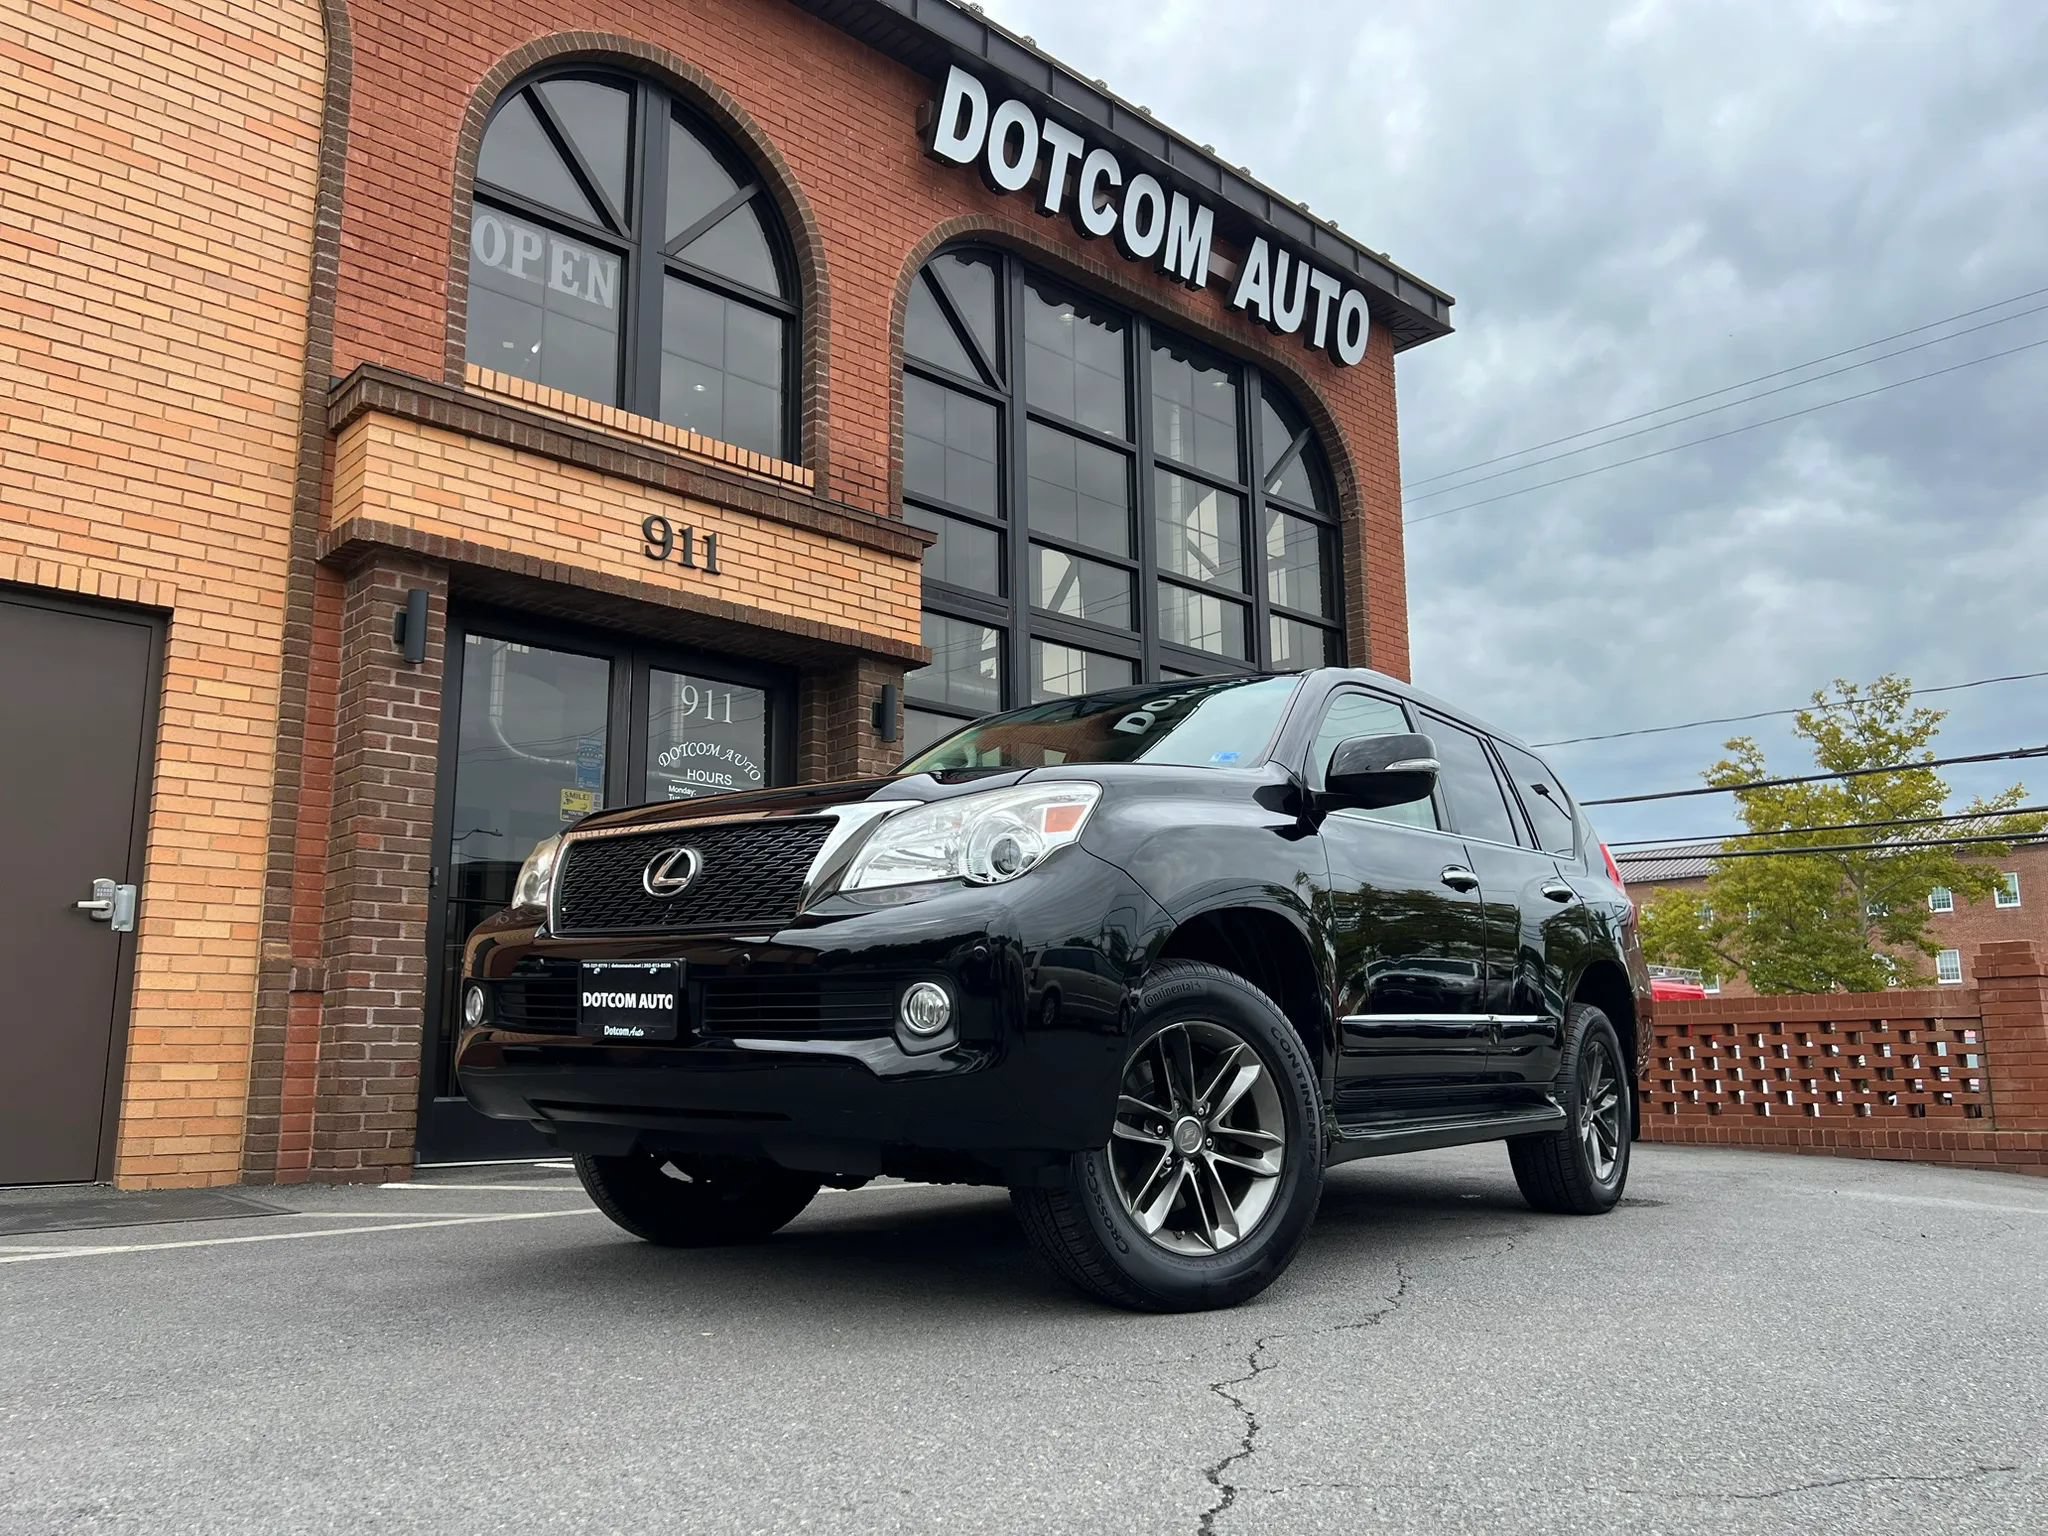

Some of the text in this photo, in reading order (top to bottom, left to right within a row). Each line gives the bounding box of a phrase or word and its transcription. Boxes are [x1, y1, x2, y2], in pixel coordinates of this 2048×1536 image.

[933, 64, 1369, 366] DOTCOM AUTO
[471, 215, 617, 309] OPEN
[642, 515, 721, 576] 911
[681, 685, 734, 724] 911
[659, 742, 761, 781] DOTCOM AUTO
[687, 768, 732, 786] HOURS
[582, 992, 674, 1010] DOTCOM AUTO
[1144, 981, 1195, 1007] Continental
[603, 1025, 629, 1036] Dotcom
